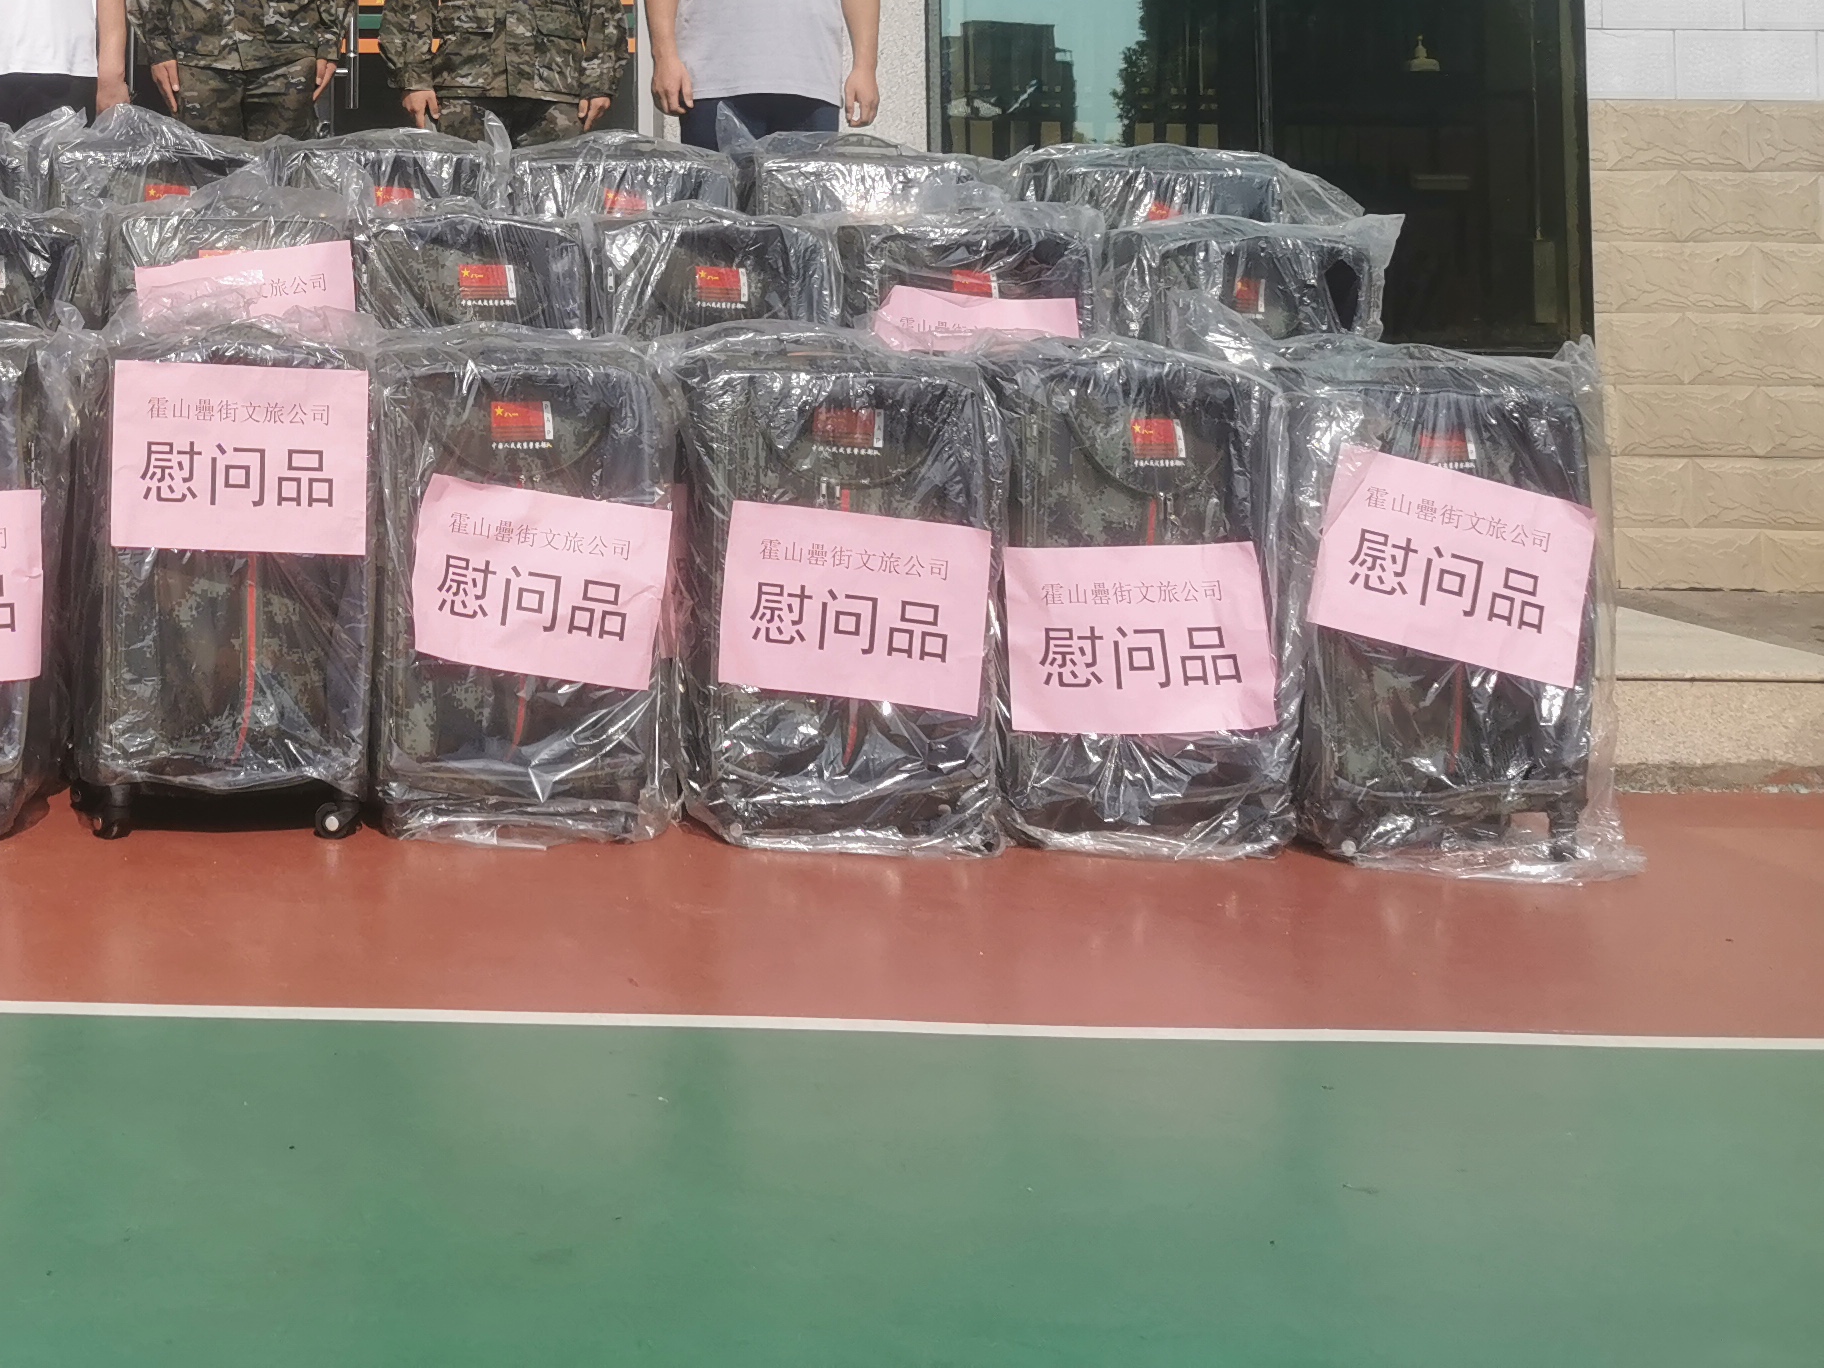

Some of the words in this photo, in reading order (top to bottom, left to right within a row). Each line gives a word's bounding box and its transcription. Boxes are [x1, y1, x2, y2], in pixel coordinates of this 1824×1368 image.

[138, 439, 336, 509] 慰问品
[436, 553, 629, 643] 慰问品
[749, 580, 950, 664] 慰问品
[1348, 527, 1547, 635] 慰问品
[1038, 624, 1244, 690] 慰问品
